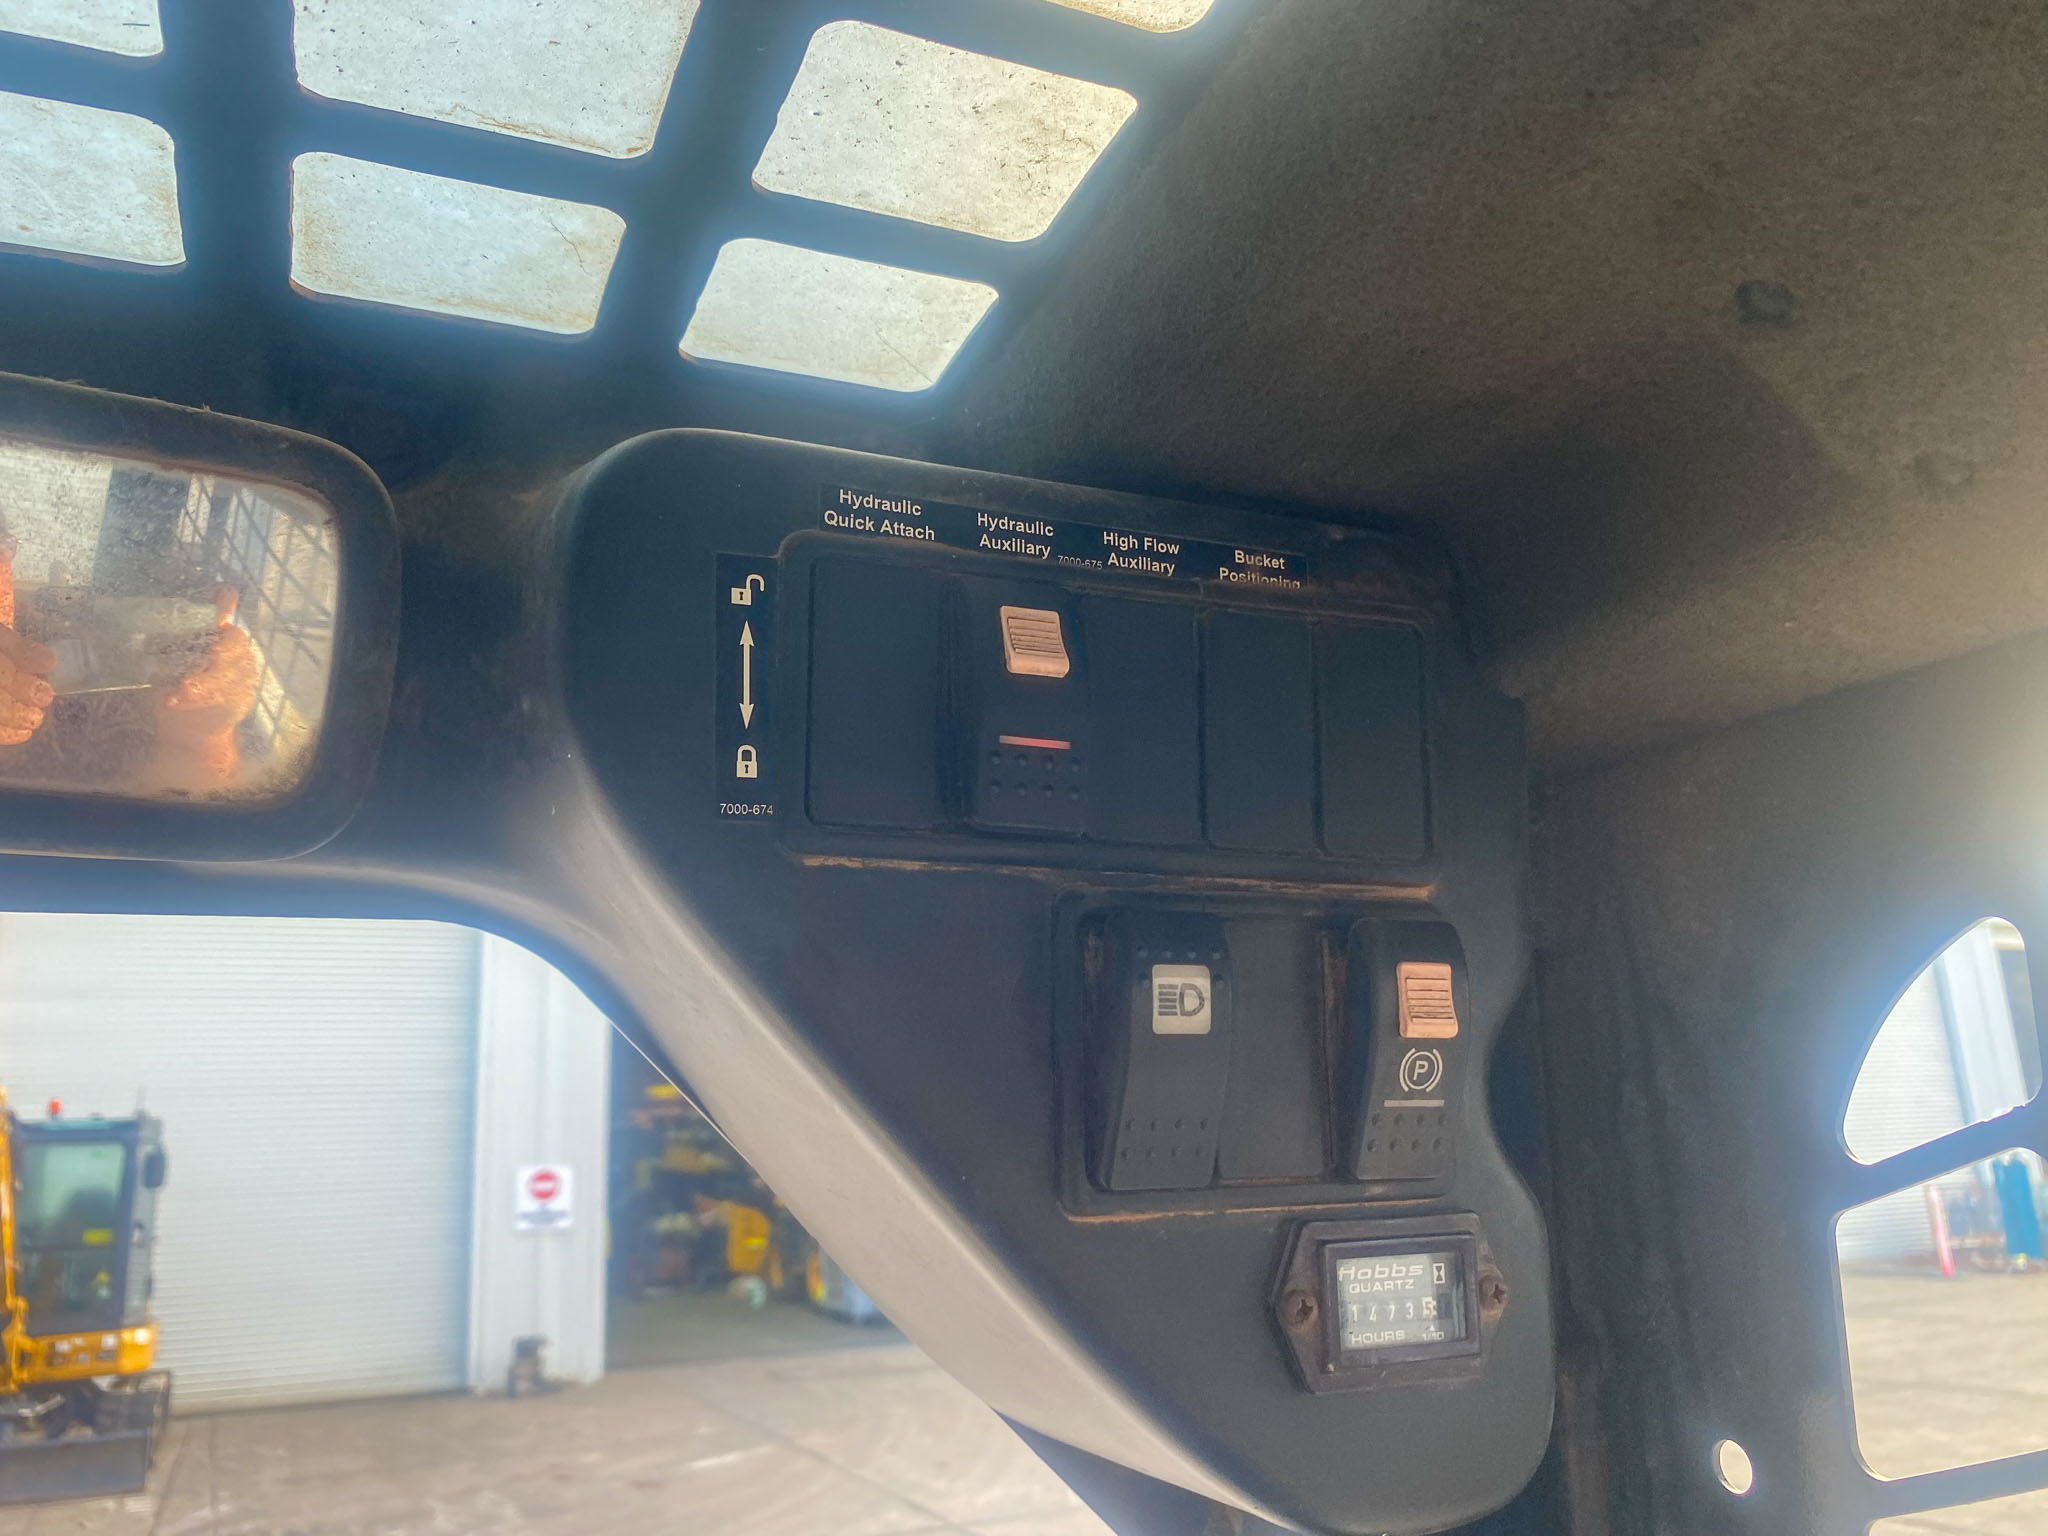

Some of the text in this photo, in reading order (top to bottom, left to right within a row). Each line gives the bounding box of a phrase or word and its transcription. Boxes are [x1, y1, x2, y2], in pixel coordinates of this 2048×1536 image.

[839, 488, 922, 516] Hydraulic
[824, 510, 935, 541] Quick Attach
[977, 512, 1054, 537] Hydraulic
[979, 533, 1051, 560] Auxiliary
[1103, 531, 1180, 555] High Flow
[1057, 555, 1103, 570] 7000-675
[1107, 552, 1175, 577] Auxiliary
[1234, 549, 1286, 569] Bucket
[719, 803, 773, 815] 7000-674
[1339, 1263, 1424, 1281] Hobbs
[1349, 1279, 1414, 1294] QUARTZ
[1351, 1330, 1405, 1344] HOURS
